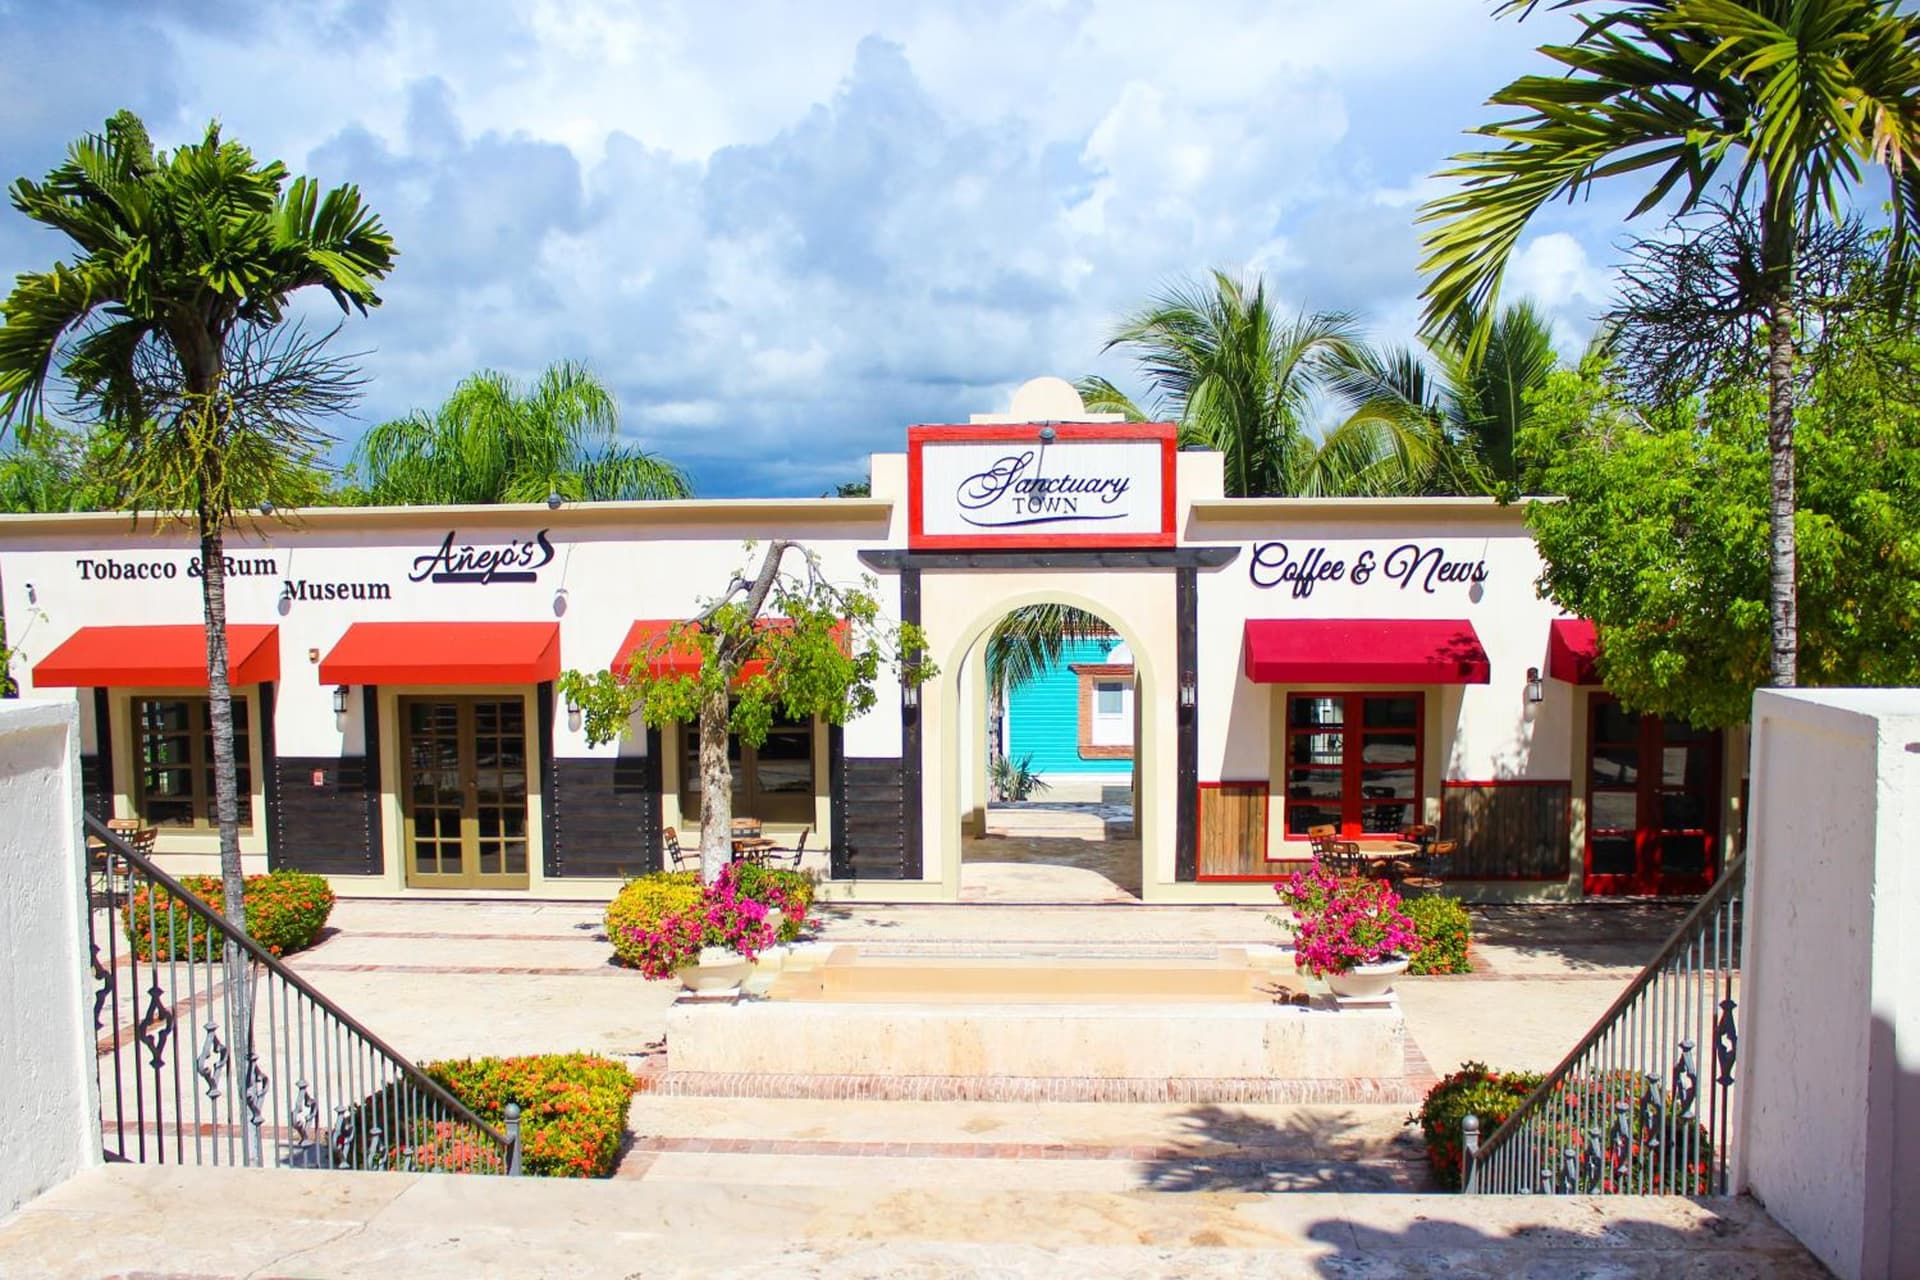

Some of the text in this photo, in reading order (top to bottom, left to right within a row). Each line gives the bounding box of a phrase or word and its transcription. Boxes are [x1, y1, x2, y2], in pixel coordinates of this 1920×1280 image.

[956, 451, 1131, 509] Sanctuary
[1012, 497, 1078, 514] TOWN
[77, 557, 278, 580] Tobacco & Rum
[1249, 542, 1490, 598] Coffee & News
[284, 580, 392, 601] Museum
